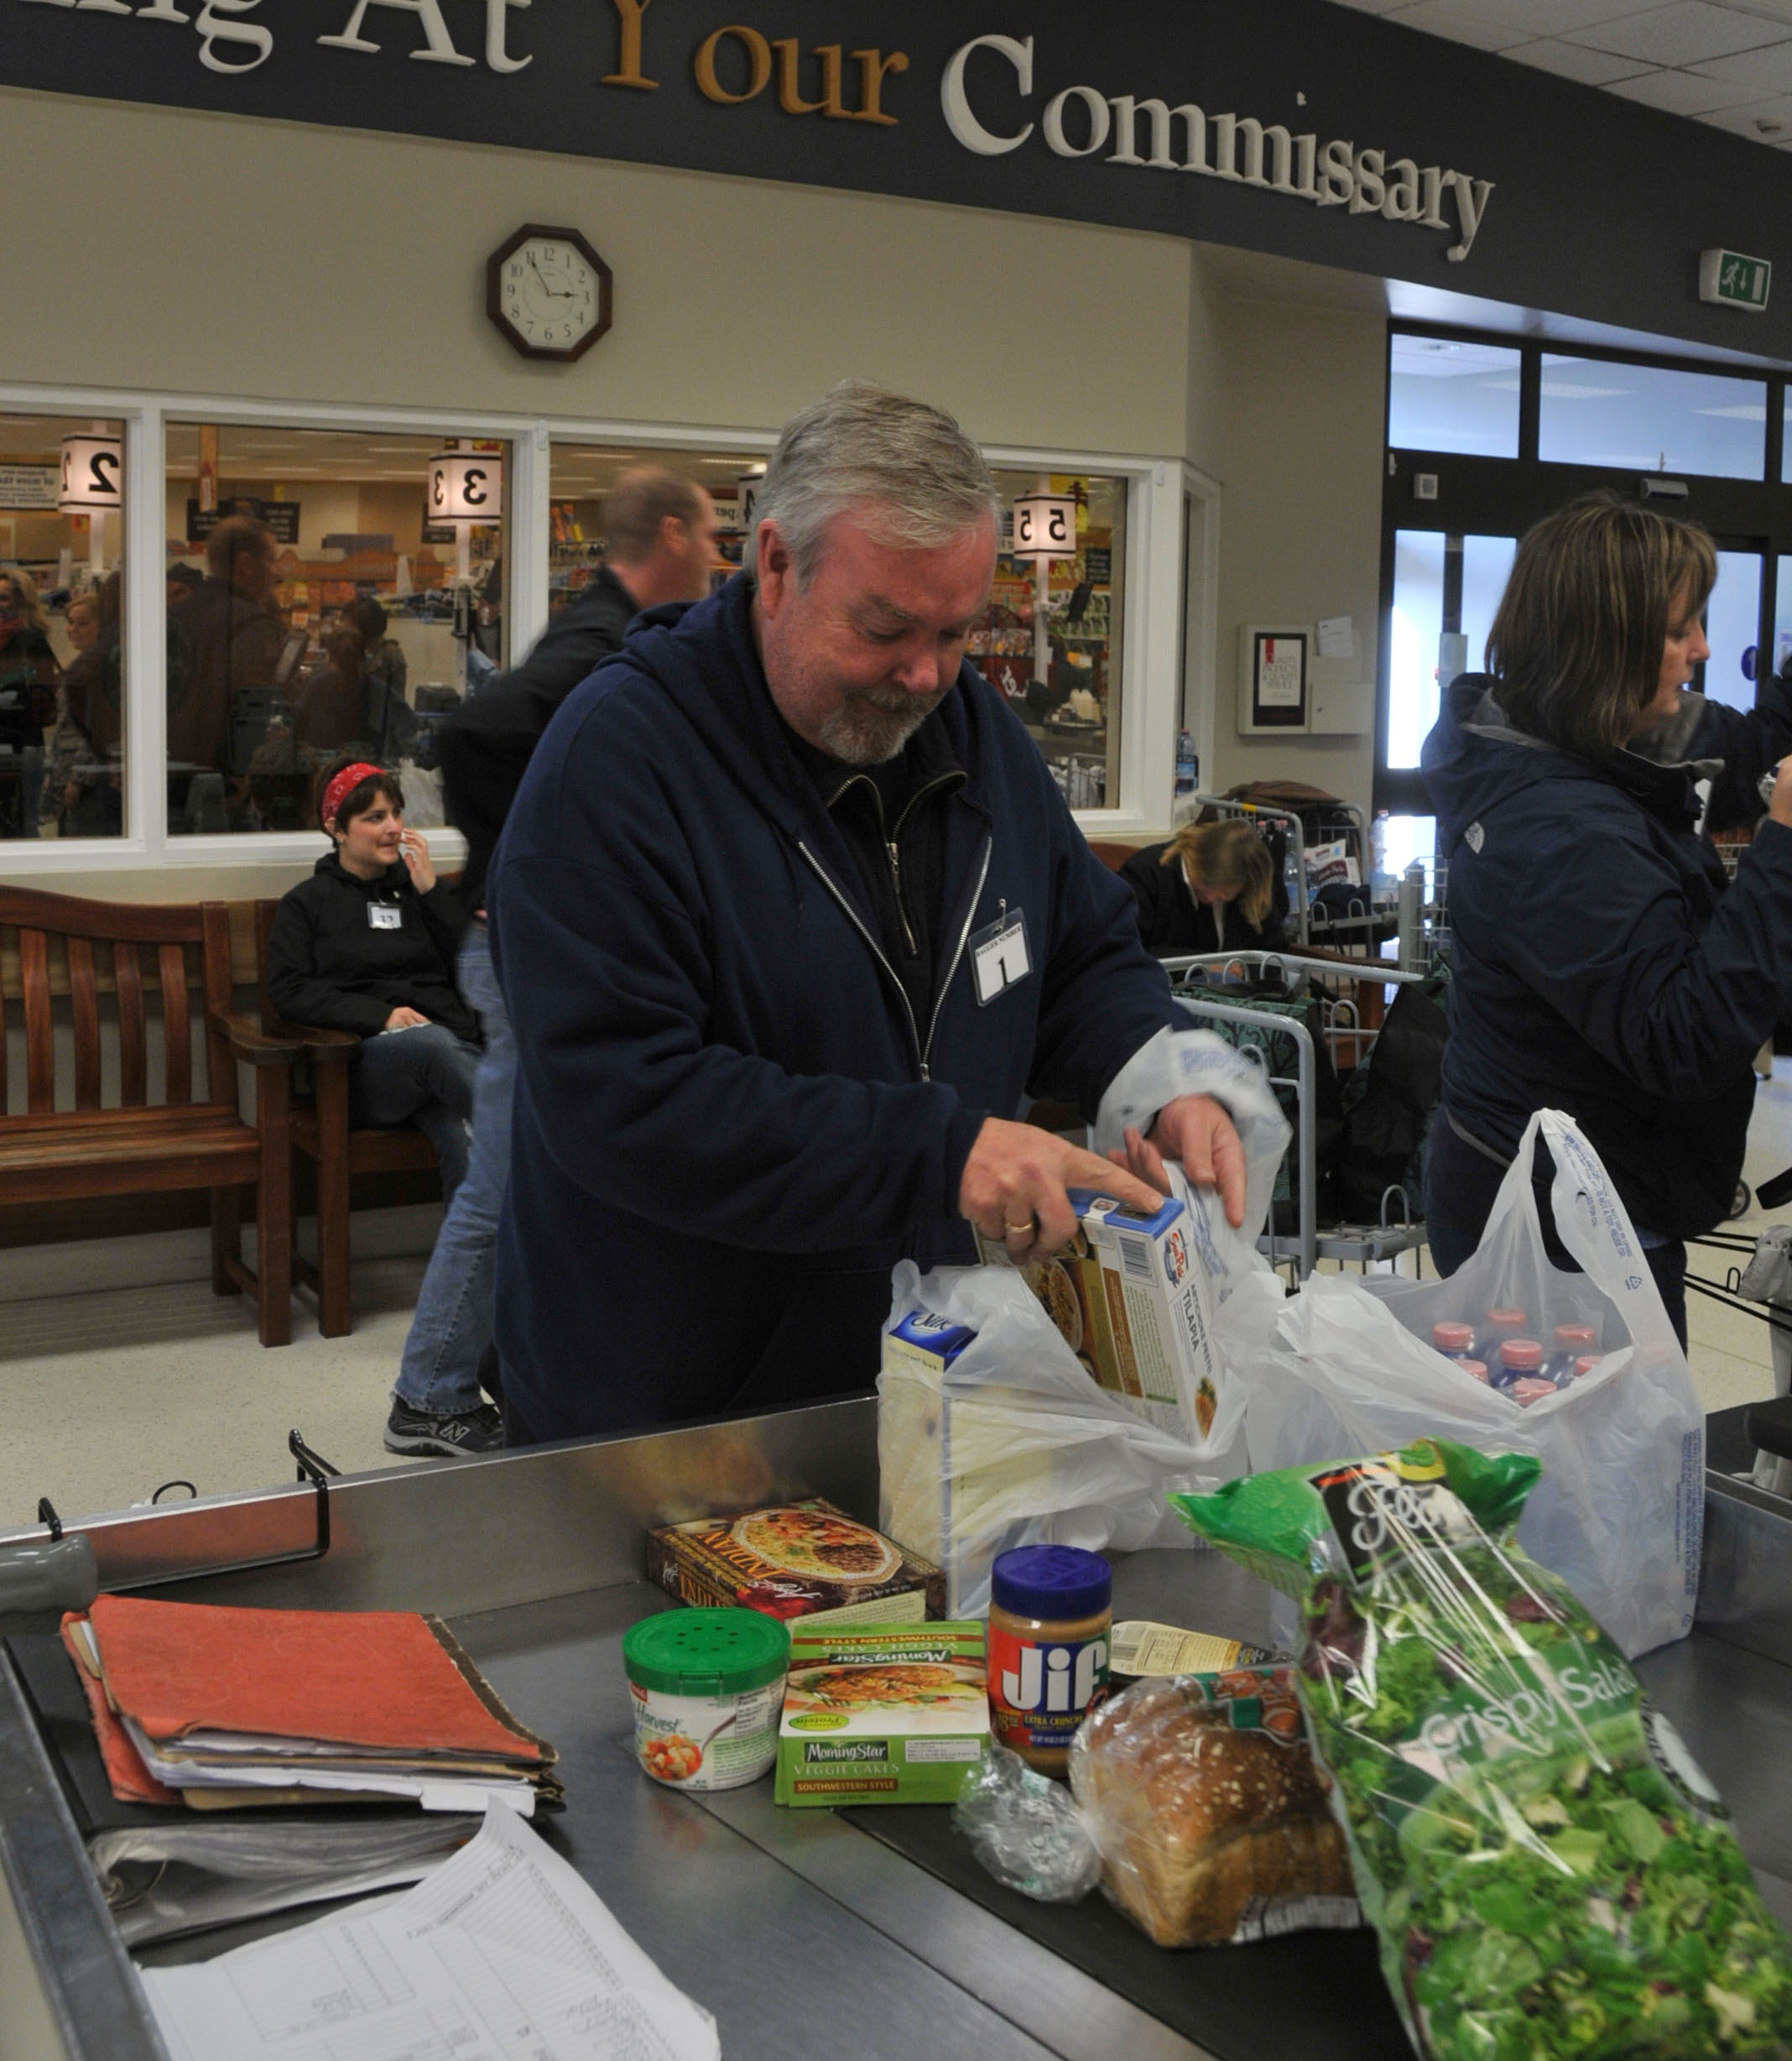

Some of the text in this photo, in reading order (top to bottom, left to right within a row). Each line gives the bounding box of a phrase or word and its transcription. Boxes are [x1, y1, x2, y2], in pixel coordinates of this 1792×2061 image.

[602, 0, 909, 125] Your
[940, 34, 1495, 262] Commissary
[544, 247, 555, 261] 12
[566, 254, 571, 269] 1
[510, 263, 524, 277] 10
[578, 270, 586, 284] 2
[507, 284, 515, 295] 9
[584, 291, 590, 305] 3
[511, 305, 520, 319] 8
[576, 311, 584, 324] 4
[526, 320, 534, 334] 7
[544, 327, 553, 340] 6
[564, 324, 571, 337] 5
[998, 956, 1008, 986] 1
[1182, 1288, 1201, 1354] TILAPIA
[695, 1528, 787, 1581] INDIAN
[859, 1634, 957, 1643] SOUTHWESTERN
[821, 1641, 959, 1653] VEGGIE CAKES
[831, 1650, 948, 1664] MorningStar
[1002, 1639, 1107, 1712] Jif
[635, 1701, 682, 1732] Harvest
[1024, 1714, 1047, 1725] EXTRA
[1420, 1687, 1558, 1757] Crispy
[806, 1743, 887, 1761] MorningStar
[793, 1764, 899, 1776] VEGGIE CAKES
[797, 1781, 896, 1792] SOUTHWESTERN STYLE
